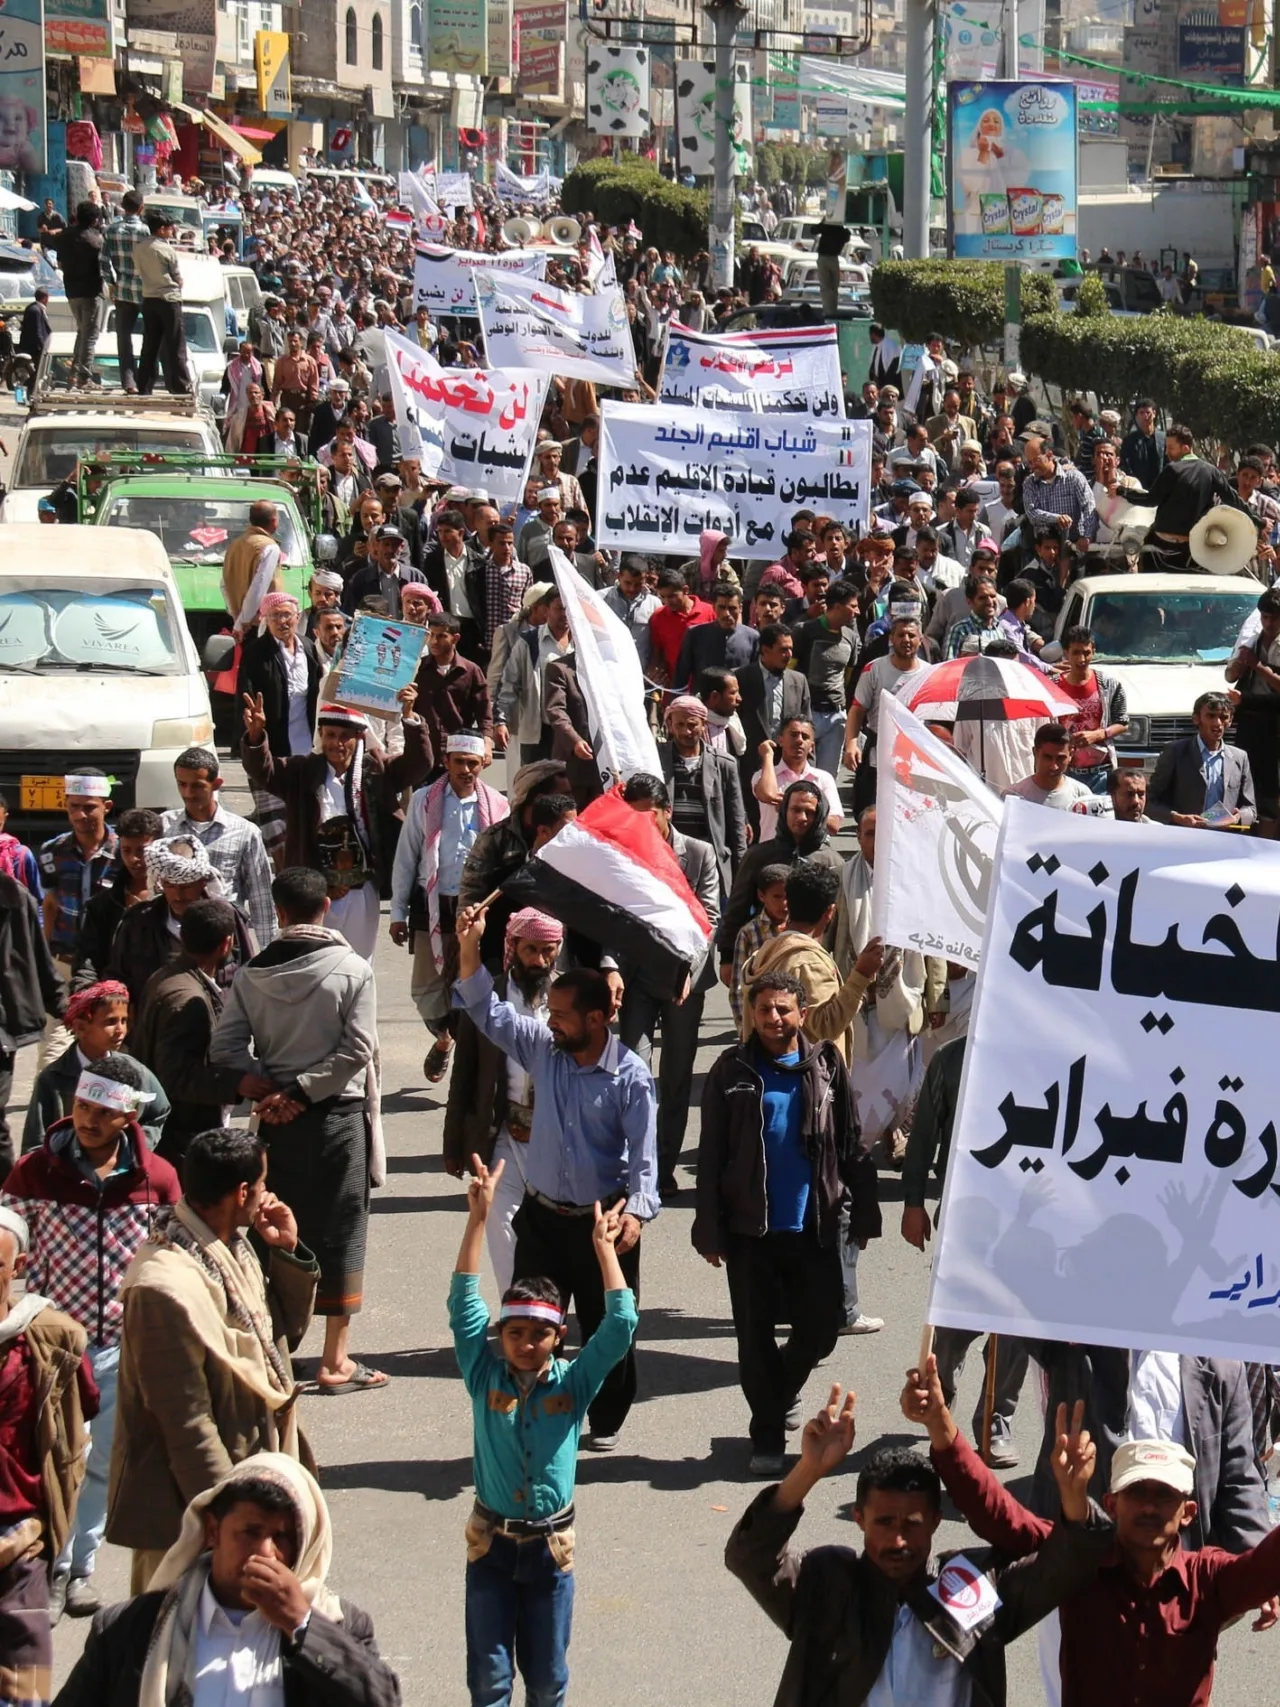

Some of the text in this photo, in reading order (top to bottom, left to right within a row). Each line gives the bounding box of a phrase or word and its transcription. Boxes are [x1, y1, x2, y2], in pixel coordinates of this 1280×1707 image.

[983, 205, 1008, 223] Crystal
[1012, 200, 1039, 220] Crystal
[1042, 207, 1063, 223] Crystal
[982, 239, 1025, 254] كريستال
[416, 284, 446, 302] يضيع
[451, 288, 464, 304] لن
[396, 350, 495, 416] تحكمنا
[499, 383, 529, 430] لن
[811, 388, 840, 418] ولن
[654, 420, 704, 451] الجند
[764, 425, 817, 459] شباب
[609, 461, 860, 507] يطالبون قيادة الإقليم عدم
[605, 503, 679, 542] الإنقلاب
[683, 502, 741, 540] أدوات
[745, 518, 775, 547] مع
[82, 636, 140, 655] VIVAREA
[970, 1053, 1189, 1186] فبراير
